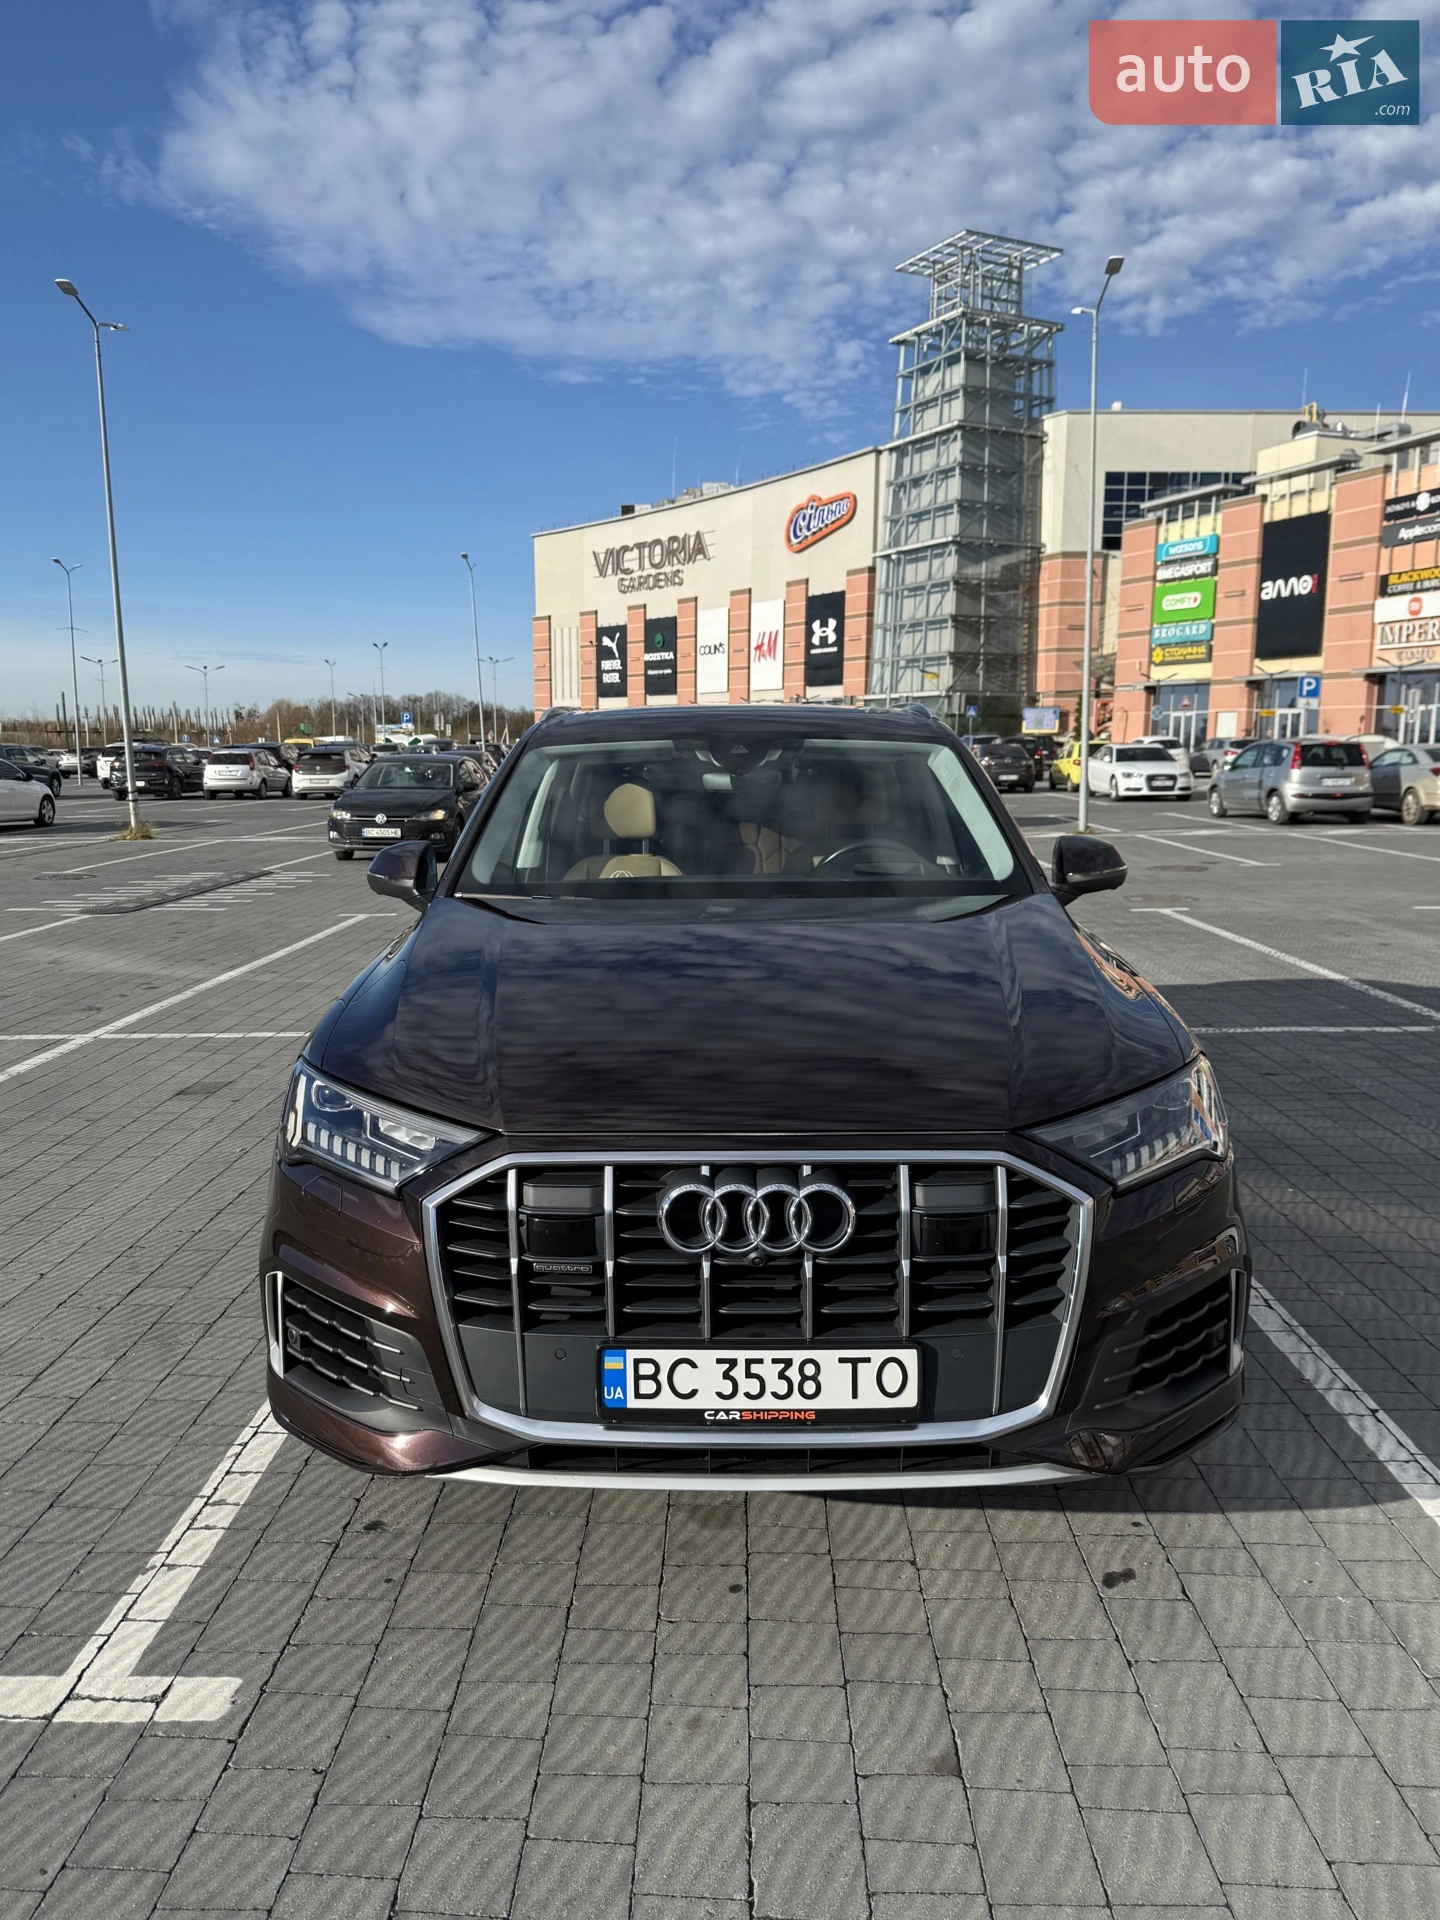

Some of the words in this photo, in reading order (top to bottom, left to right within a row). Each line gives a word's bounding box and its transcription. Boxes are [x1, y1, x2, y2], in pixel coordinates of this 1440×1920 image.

[789, 498, 851, 544] Сільпо
[592, 530, 711, 578] VICTORIA
[617, 569, 684, 594] GARDENS
[1153, 624, 1206, 639] BROCARD
[753, 629, 779, 662] H&M
[644, 651, 675, 661] ROZETKA
[1302, 678, 1317, 697] P
[535, 1265, 590, 1273] quattro
[633, 1357, 699, 1400] BC
[714, 1357, 822, 1401] 3538
[838, 1356, 909, 1399] TO
[604, 1386, 624, 1399] UA
[704, 1410, 816, 1420] CARSHIPPING
